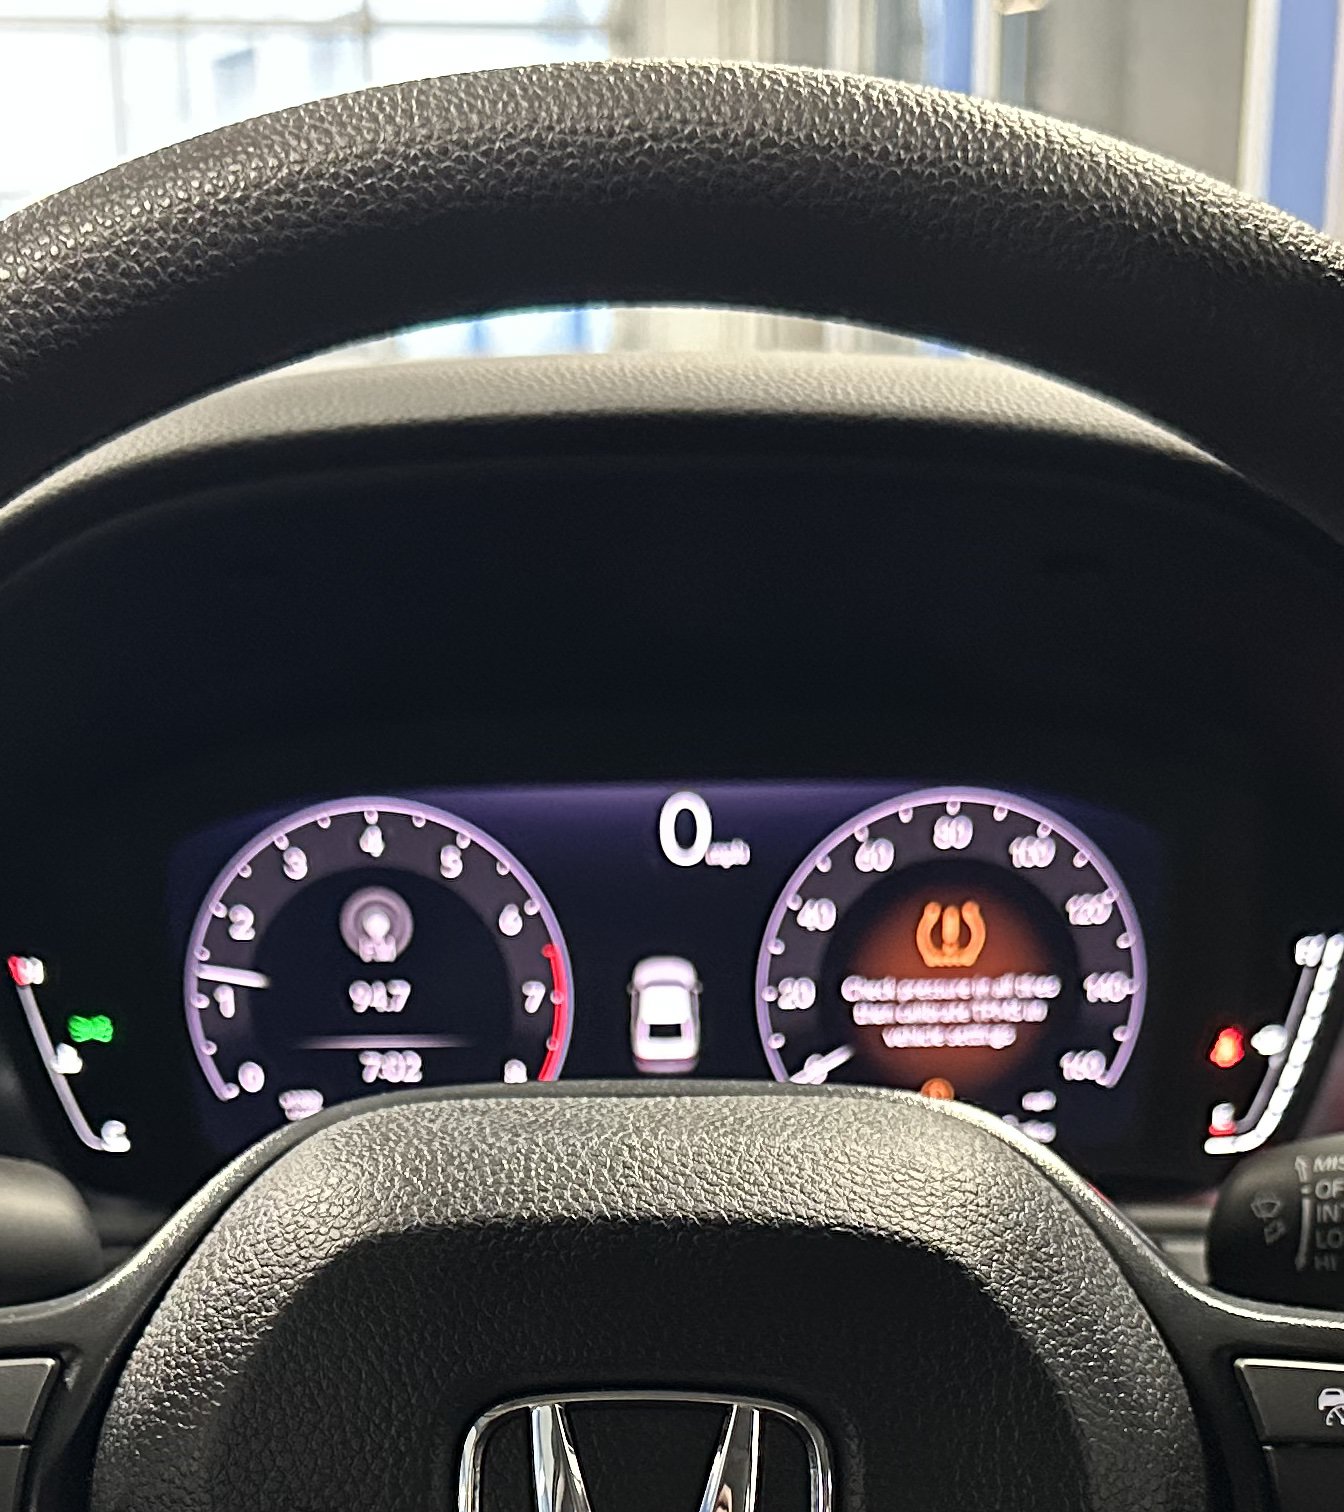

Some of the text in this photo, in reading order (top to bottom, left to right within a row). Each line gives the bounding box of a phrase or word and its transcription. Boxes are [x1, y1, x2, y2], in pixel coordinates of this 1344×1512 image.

[659, 791, 712, 867] 0
[229, 905, 255, 940] 2
[522, 980, 546, 1014] 7
[1315, 1228, 1344, 1249] LO
